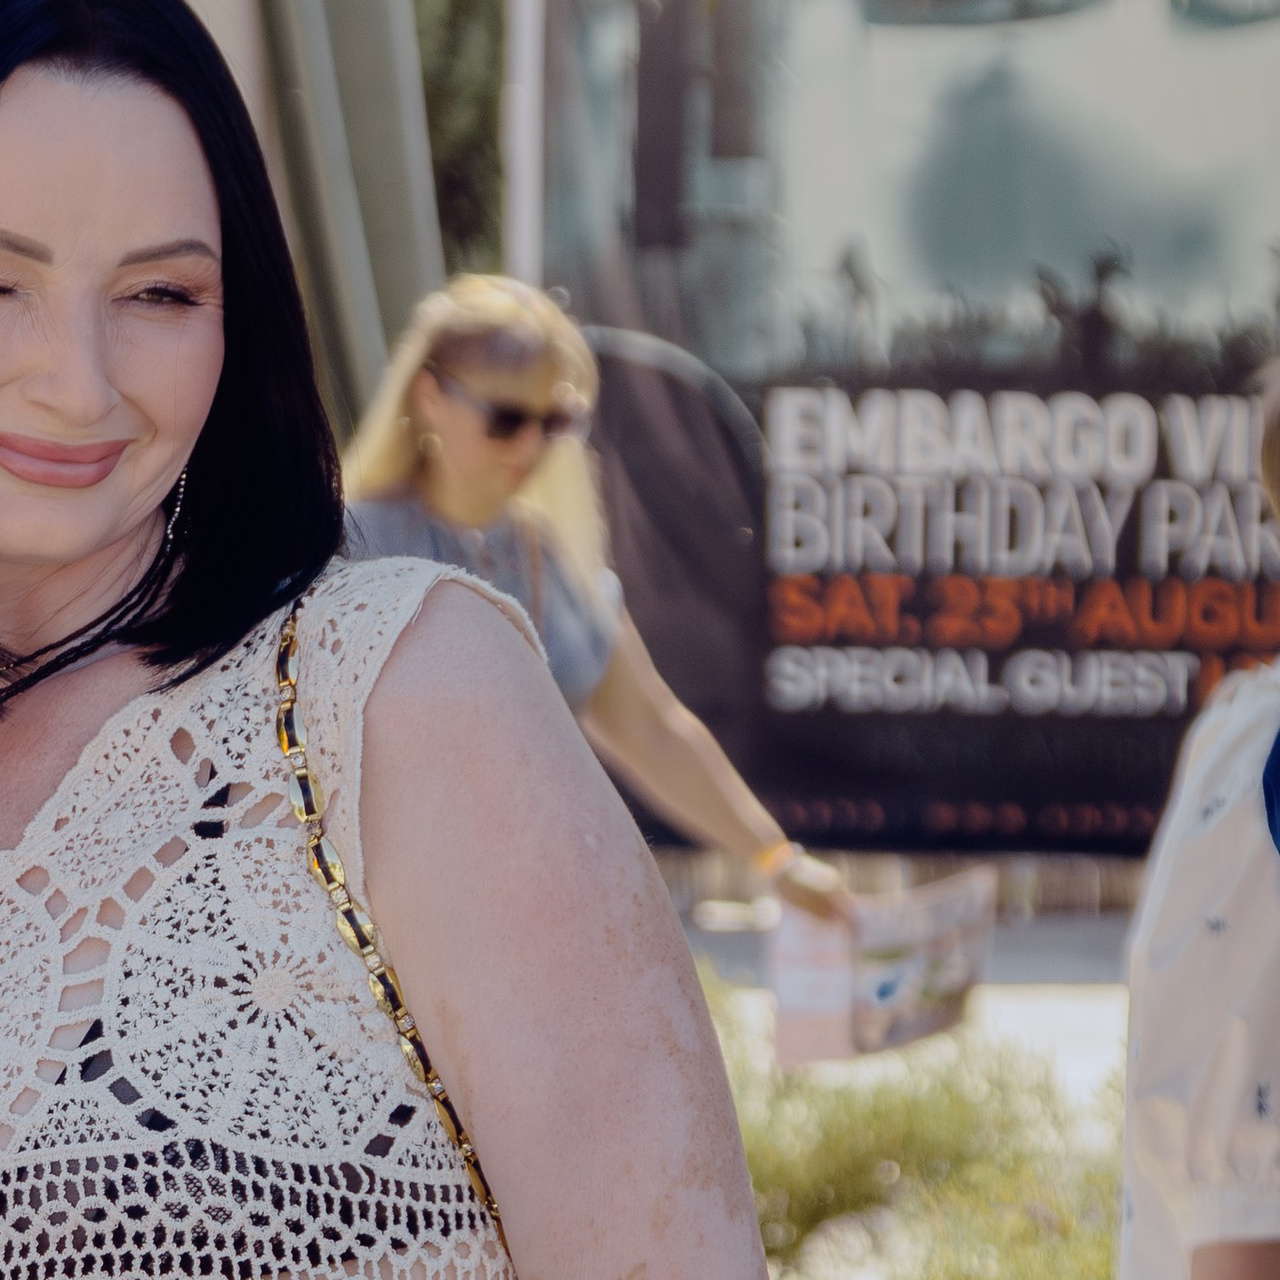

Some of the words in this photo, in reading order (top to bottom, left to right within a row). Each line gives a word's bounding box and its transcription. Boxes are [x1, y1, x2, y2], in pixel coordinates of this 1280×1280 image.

[764, 387, 1160, 488] EMBARGO
[766, 472, 1136, 578] BIRTHDAY
[764, 645, 1010, 712] SPECIAL
[1002, 648, 1202, 718] GUEST
